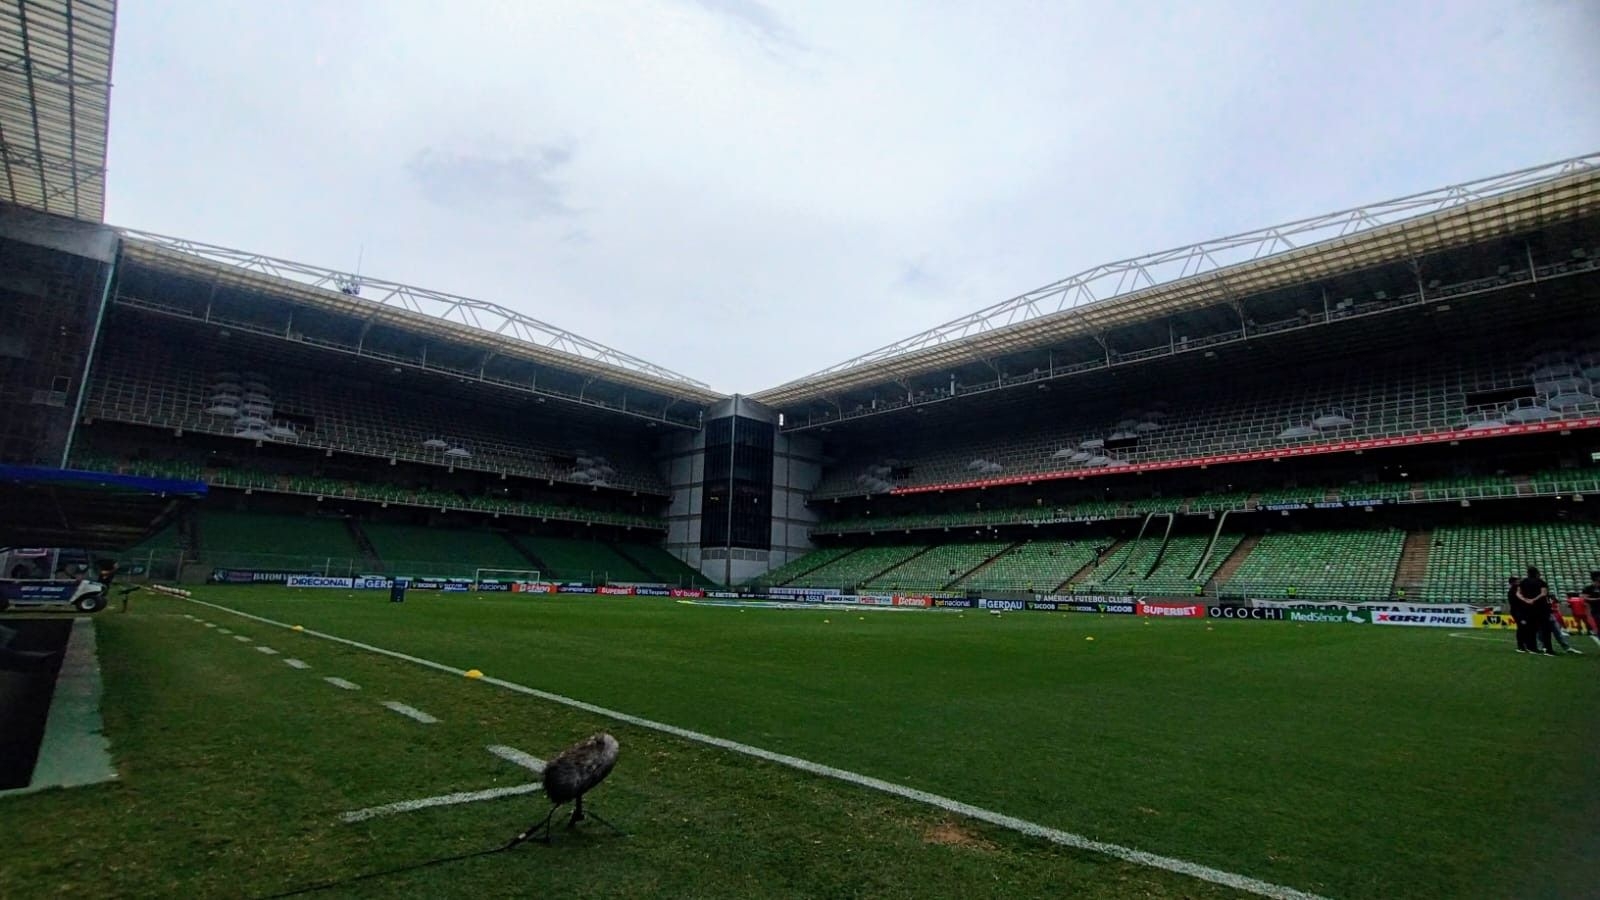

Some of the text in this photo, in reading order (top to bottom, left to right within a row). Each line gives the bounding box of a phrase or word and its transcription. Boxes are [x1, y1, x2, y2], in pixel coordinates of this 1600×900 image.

[1266, 503, 1309, 512] TORCIDA
[1348, 499, 1384, 507] VERDE
[291, 578, 349, 586] DIRECIONAL
[898, 596, 927, 606] Betano
[1043, 594, 1074, 602] AMÉRICA
[1075, 595, 1105, 603] FUTEBOL
[987, 600, 1023, 609] GERDAU
[1106, 605, 1134, 613] SICOOB
[1143, 604, 1197, 616] SUPERBET
[1210, 607, 1283, 619] OGOCHI
[1430, 616, 1467, 625] PNEUS
